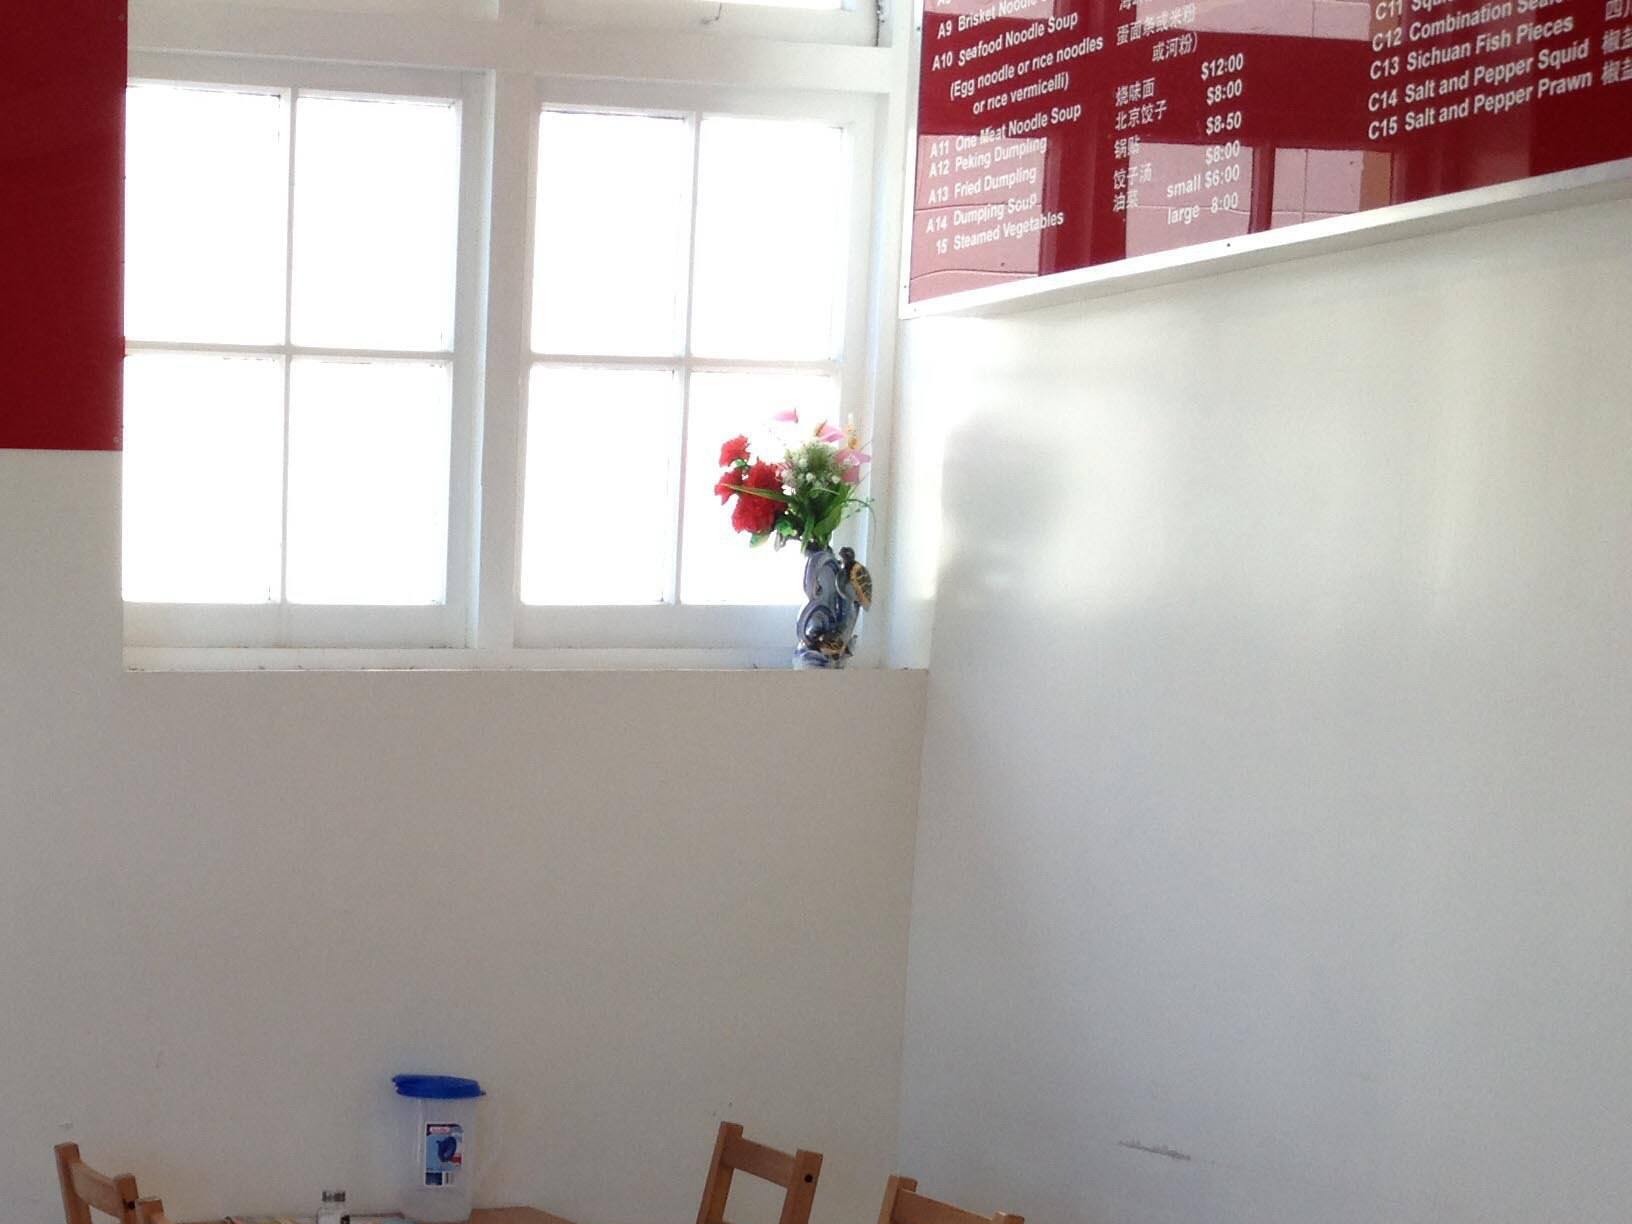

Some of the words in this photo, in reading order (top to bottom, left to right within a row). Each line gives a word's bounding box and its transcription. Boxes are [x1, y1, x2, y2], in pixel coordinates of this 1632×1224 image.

[937, 20, 952, 39] A9
[958, 6, 996, 31] Brisket
[1372, 27, 1403, 52] C12
[1409, 2, 1512, 42] Combination
[1375, 0, 1403, 20] C11
[932, 51, 953, 71] A10
[958, 34, 1003, 67] Seafood
[1005, 22, 1045, 49] Noodle
[1047, 12, 1079, 34] Soup
[1370, 56, 1400, 80] C13
[1407, 40, 1471, 72] Sichuan
[1475, 30, 1511, 55] Fish
[1516, 16, 1574, 44] Pieces
[950, 80, 975, 101] (Egg
[977, 63, 1015, 89] noodle
[1017, 60, 1030, 75] or
[1032, 53, 1054, 71] rice
[1056, 36, 1104, 59] noodles
[1200, 52, 1244, 81] $12:00
[1368, 88, 1398, 112] C14
[1405, 81, 1435, 104] Salt
[1439, 71, 1469, 97] and
[1473, 55, 1534, 88] Pepper
[1537, 37, 1590, 70] Squid
[973, 101, 984, 115] or
[987, 93, 1008, 112] rice
[1011, 71, 1070, 105] vermicelli)
[1206, 78, 1243, 106] $8:00
[1368, 116, 1398, 141] C15
[1405, 109, 1435, 132] Salt
[1439, 98, 1469, 124] and
[1473, 85, 1534, 116] Pepper
[1537, 71, 1593, 99] Prawn
[929, 141, 950, 159] A11
[955, 135, 977, 153] One
[979, 126, 1006, 145] Meat
[1008, 115, 1048, 138] Noodle
[1050, 103, 1081, 125] Soup
[1115, 100, 1167, 131] 北京饺子
[928, 160, 950, 178] A12
[955, 150, 992, 172] Peking
[994, 136, 1048, 163] Dumpling
[927, 186, 949, 205] A13
[954, 176, 981, 199] Fried
[983, 166, 1037, 189] Dumpling
[1166, 174, 1201, 198] small
[926, 215, 948, 234] A14
[953, 202, 1005, 227] Dumpling
[1008, 192, 1038, 214] Soup
[953, 225, 1000, 251] Steamed
[1003, 211, 1064, 239] Vegetables
[1167, 204, 1200, 225] large
